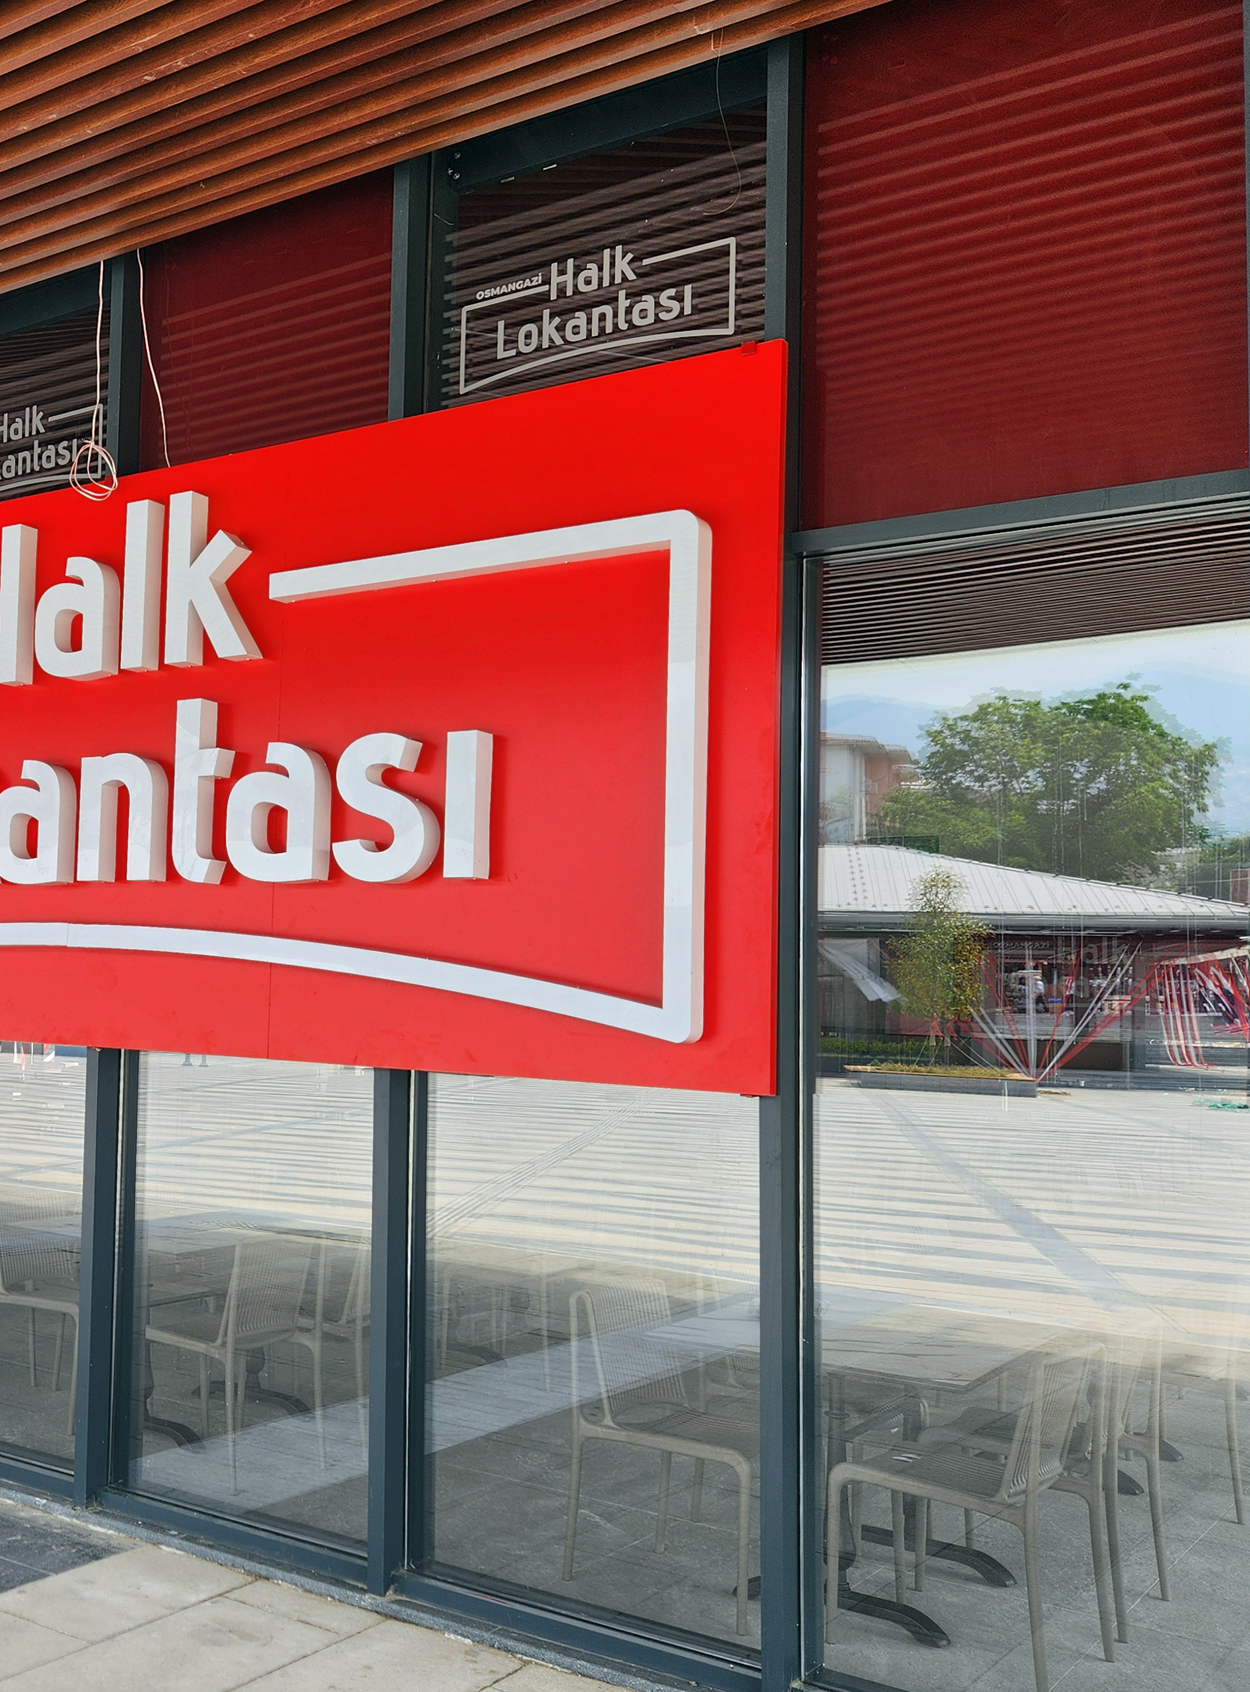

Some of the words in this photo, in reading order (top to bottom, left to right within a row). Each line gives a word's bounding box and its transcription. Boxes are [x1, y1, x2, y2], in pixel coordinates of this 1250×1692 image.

[475, 273, 543, 301] OSMANGAZİ
[550, 244, 638, 301] Halk
[496, 283, 693, 360] Lokantası
